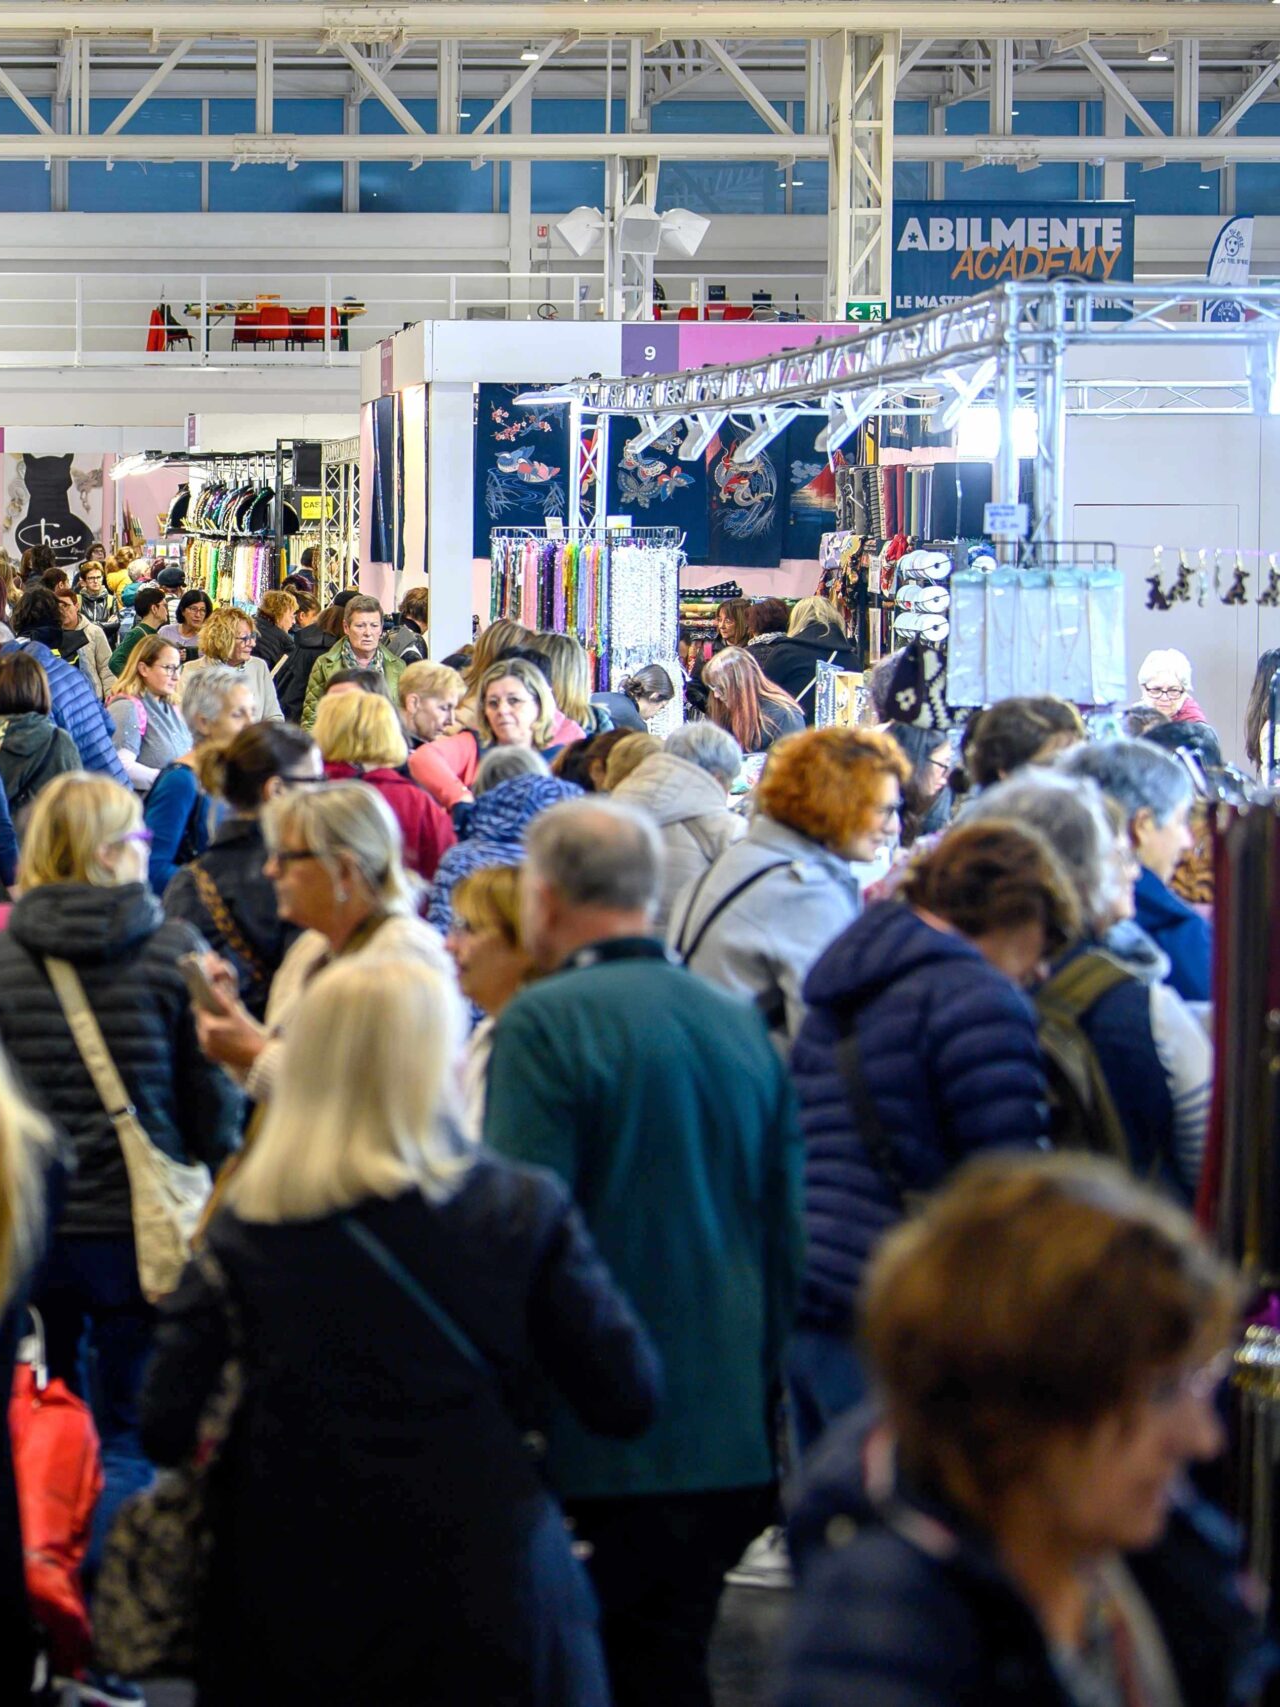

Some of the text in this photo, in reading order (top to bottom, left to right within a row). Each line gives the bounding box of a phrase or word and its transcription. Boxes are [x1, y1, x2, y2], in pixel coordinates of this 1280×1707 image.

[897, 217, 1122, 251] ABILMENTE
[951, 246, 1122, 281] ACADEMY
[895, 295, 912, 309] LE
[644, 345, 657, 361] 9
[303, 501, 331, 509] CASA
[18, 517, 82, 549] Checa
